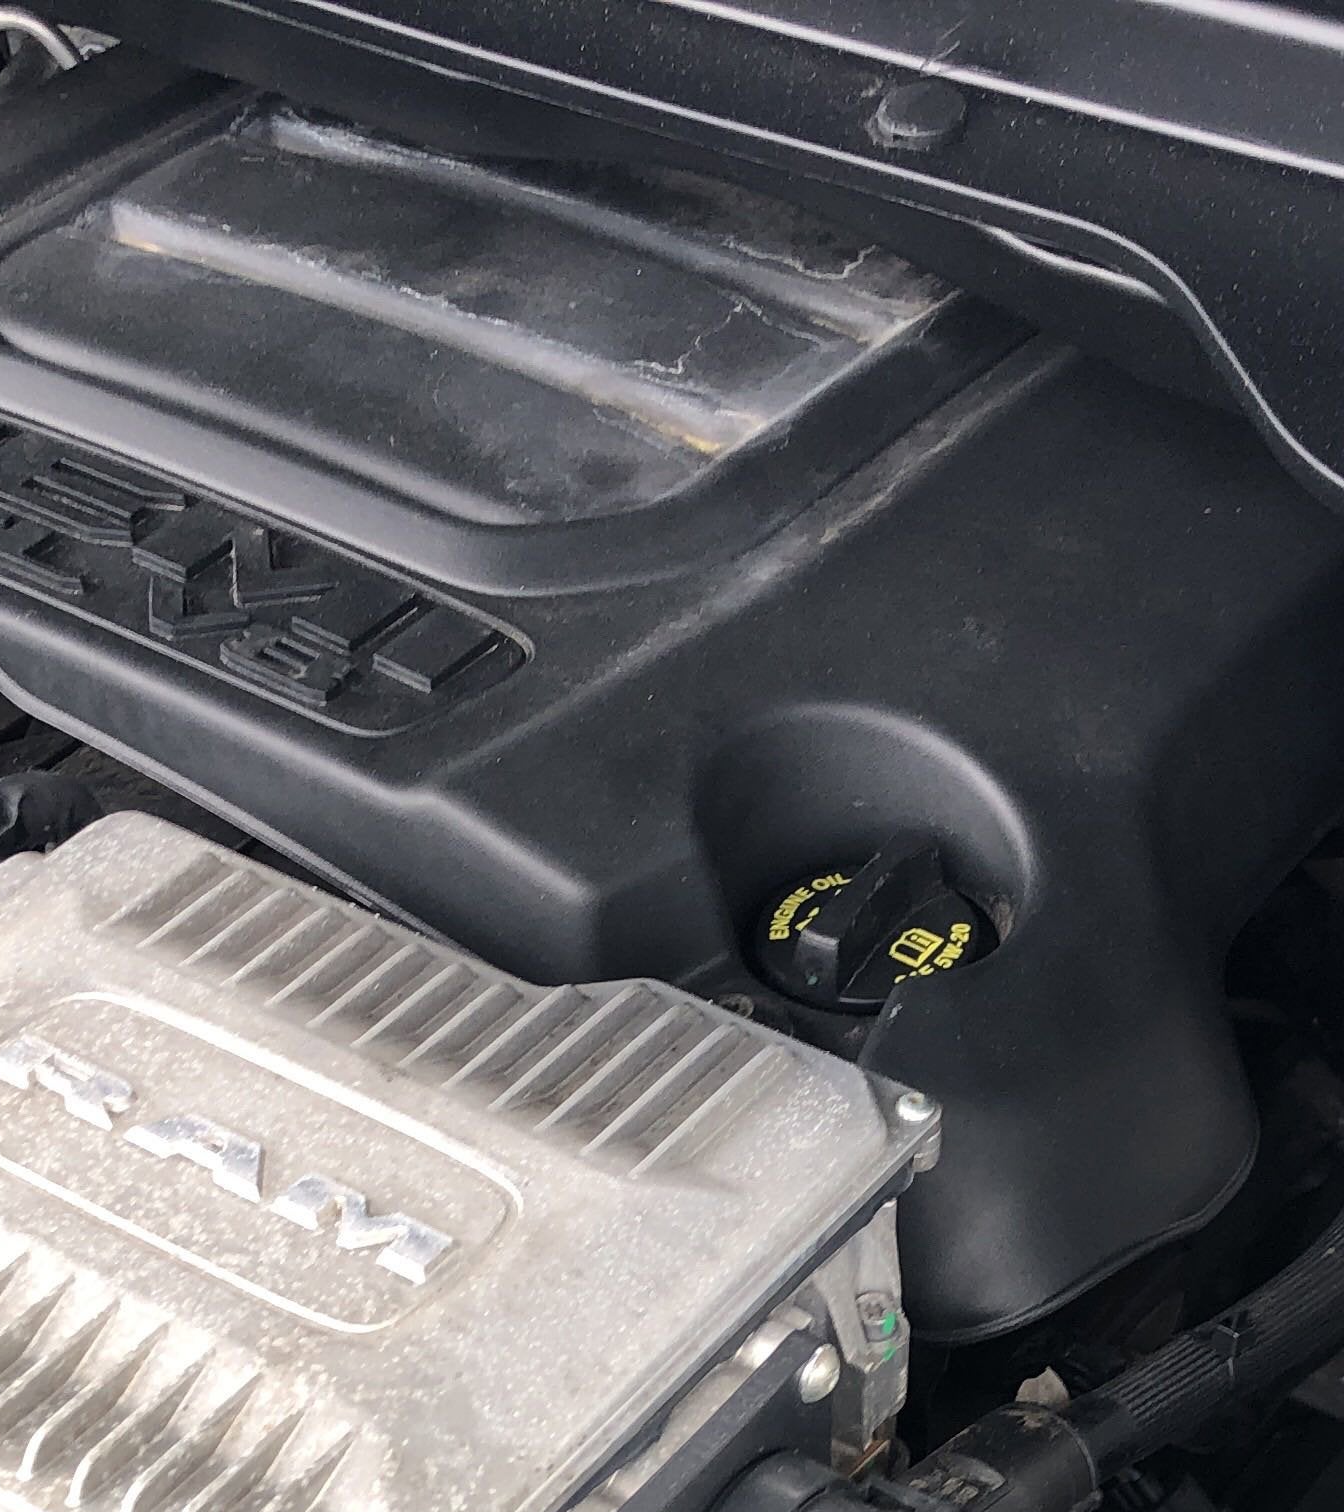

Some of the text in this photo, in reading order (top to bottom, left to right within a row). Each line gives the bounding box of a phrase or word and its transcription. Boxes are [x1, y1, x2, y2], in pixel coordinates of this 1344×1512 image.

[768, 872, 853, 941] ENGINE OIL
[933, 922, 973, 970] 5W-20
